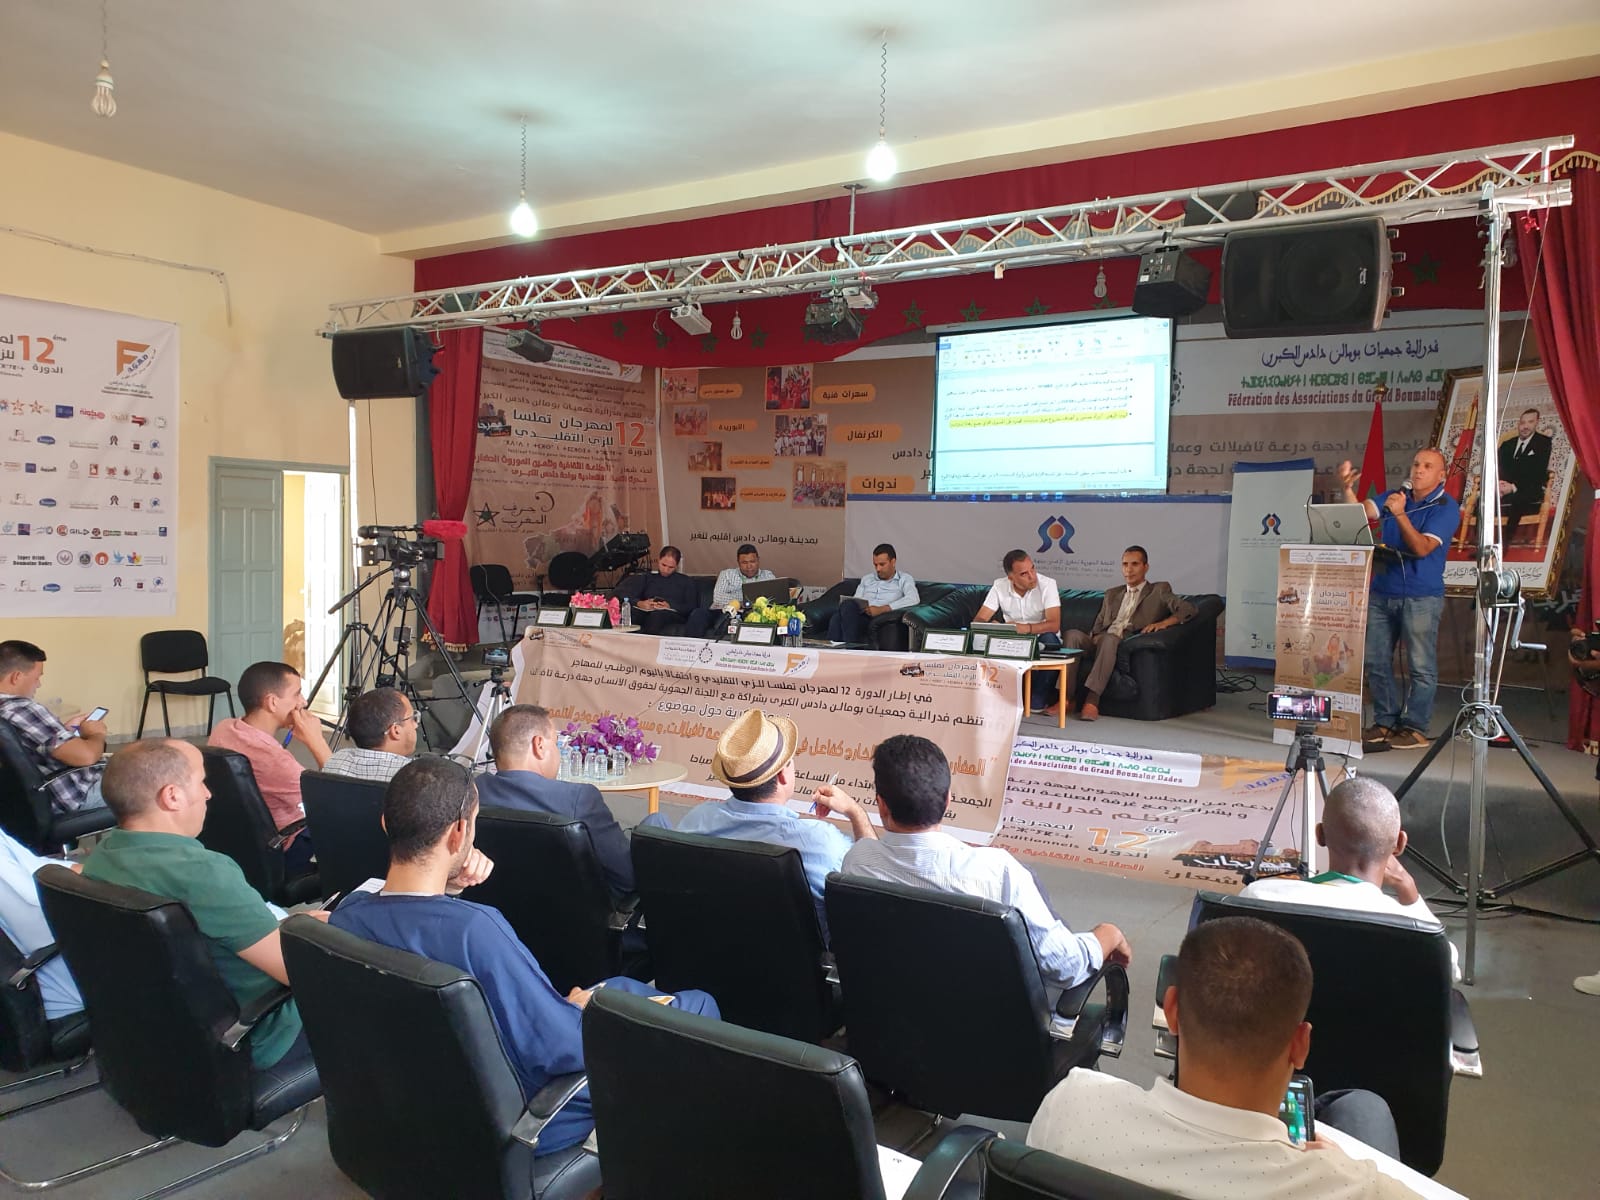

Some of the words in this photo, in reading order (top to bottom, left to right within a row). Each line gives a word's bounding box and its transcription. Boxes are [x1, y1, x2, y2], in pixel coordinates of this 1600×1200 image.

[17, 335, 55, 364] 12
[1329, 342, 1361, 365] بومالن
[1364, 341, 1402, 359] جمعيات
[1405, 338, 1439, 359] فدرالية
[1261, 343, 1301, 368] الكبرى
[1293, 343, 1327, 368] دادس
[32, 364, 63, 374] الدورة
[505, 396, 530, 404] دادس
[822, 391, 839, 399] فنية
[842, 390, 868, 400] سهرات
[1228, 392, 1273, 407] Fédération
[1274, 391, 1290, 405] des
[1291, 389, 1349, 404] Associations
[1352, 389, 1363, 403] du
[531, 399, 560, 410] بومالن
[513, 409, 552, 424] تملسا
[559, 416, 613, 432] لمهرجان
[515, 428, 584, 443] التقليدي
[615, 421, 646, 447] 12
[847, 429, 883, 441] الكرنفال
[892, 447, 922, 460] دادس
[1209, 440, 1264, 455] تافيلالت
[1268, 440, 1307, 456] درعة
[1186, 463, 1224, 478] لجهة
[862, 478, 897, 492] ندوات
[709, 531, 731, 543] إقليم
[733, 532, 756, 543] دادس
[757, 533, 787, 545] بومالن
[788, 535, 818, 545] بمدينة
[570, 657, 602, 669] للمهاجر
[604, 663, 638, 675] الوطني
[948, 663, 978, 671] لمهرجان
[553, 669, 574, 682] درعة
[575, 673, 593, 682] جهة
[639, 666, 664, 678] باليوم
[665, 669, 692, 681] احتفالا
[980, 664, 999, 682] 12
[694, 675, 699, 683] و
[701, 674, 738, 686] التقليدي
[741, 679, 765, 690] للزي
[628, 682, 657, 691] لحقوق
[658, 684, 693, 695] الجهوية
[767, 680, 796, 691] تملسا
[799, 683, 839, 695] لمهرجان
[841, 686, 851, 696] 12
[694, 687, 719, 698] اللجنة
[720, 692, 735, 701] مع
[737, 691, 768, 705] بشراكة
[854, 687, 886, 700] الدورة
[887, 690, 911, 704] إطار
[913, 693, 933, 704] في
[657, 701, 696, 714] موضوع
[769, 696, 799, 707] الكبرى
[800, 700, 828, 710] دادس
[699, 704, 721, 717] حول
[829, 702, 864, 714] بومالن
[865, 704, 906, 720] جمعيات
[908, 708, 950, 724] فدرالية
[953, 715, 984, 726] تنظم
[809, 737, 844, 757] كفاعل
[1032, 742, 1059, 752] دادس
[1061, 743, 1088, 755] بومالن
[1089, 744, 1123, 758] جمعيات
[690, 753, 713, 765] صباحا
[1125, 751, 1153, 761] فدرالية
[795, 769, 830, 783] الساعة
[1028, 759, 1077, 771] Associations
[1079, 764, 1089, 772] du
[1090, 766, 1114, 775] Grand
[1157, 774, 1183, 783] Dades
[1007, 776, 1040, 785] درعة
[1043, 780, 1077, 790] لجهة
[1040, 790, 1096, 802] الصناعة
[1080, 786, 1140, 798] الجهوي
[1100, 797, 1137, 807] غرفة
[1143, 795, 1198, 804] المجلس
[1021, 798, 1103, 815] فدرالية
[1231, 802, 1274, 812] بدعم
[1112, 812, 1179, 824] تنظم
[1087, 827, 1151, 852] 12
[1087, 845, 1149, 859] الدورة
[1083, 857, 1145, 871] الصناعة
